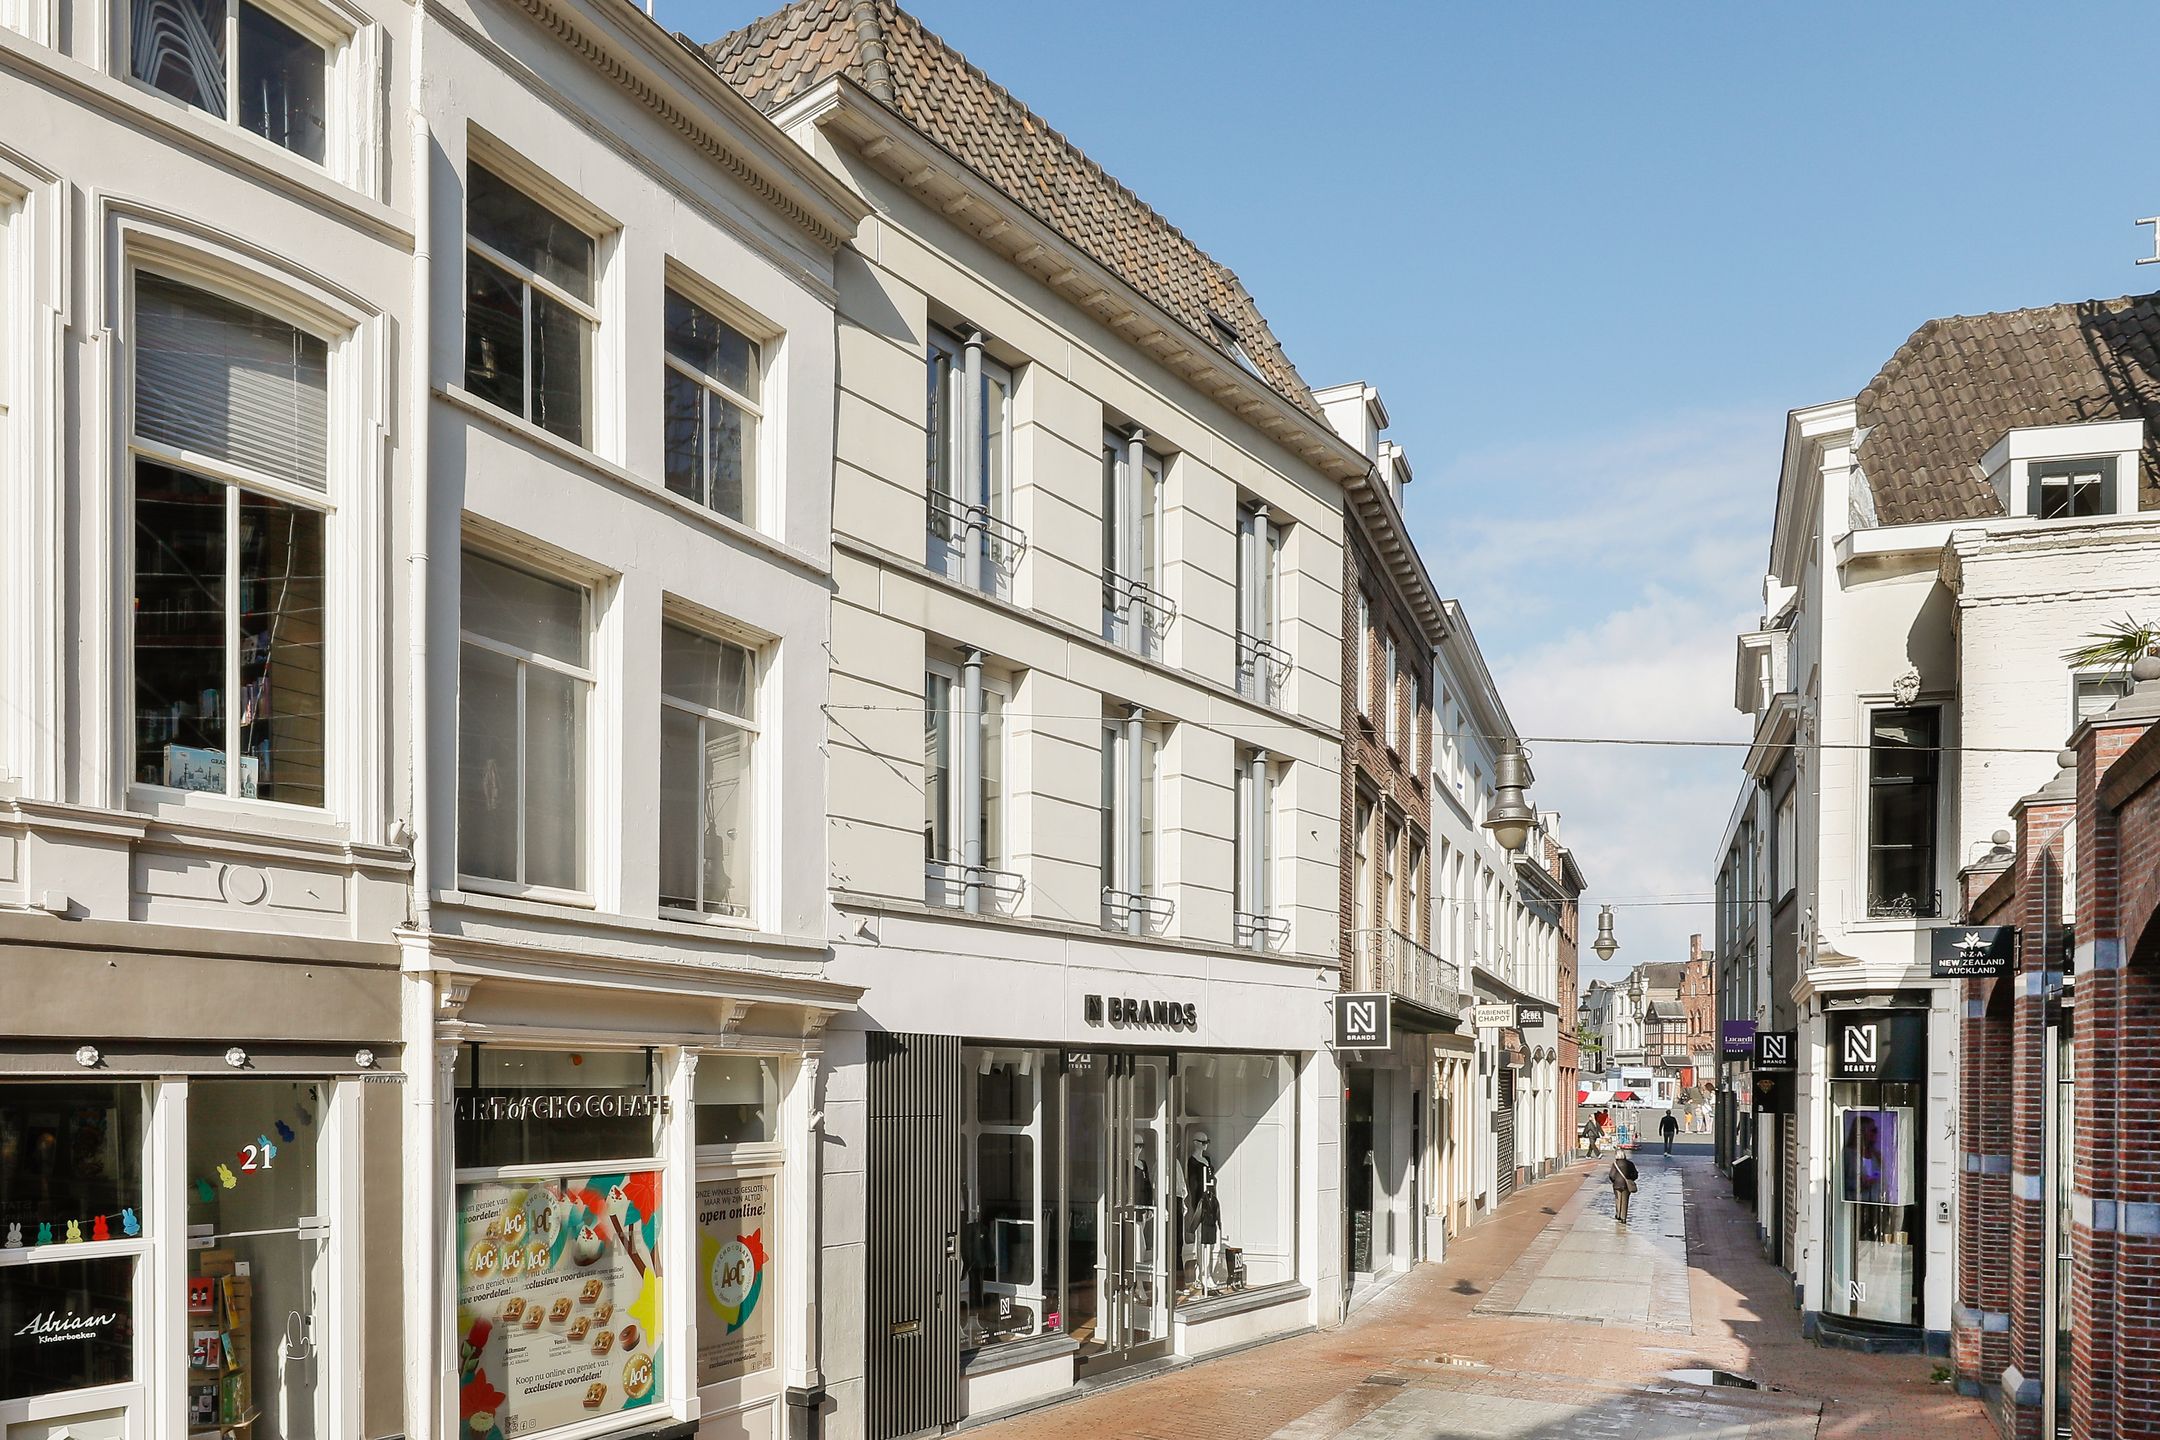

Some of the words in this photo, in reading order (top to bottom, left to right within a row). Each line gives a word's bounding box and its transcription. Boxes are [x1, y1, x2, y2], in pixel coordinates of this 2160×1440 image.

[1939, 959, 1960, 967] NEW
[1962, 958, 2005, 966] ZEALAND
[1947, 967, 1996, 975] AUCKLAND
[1083, 995, 1102, 1021] N
[1108, 997, 1196, 1027] BRANDS
[1346, 1001, 1376, 1033] N
[1477, 1015, 1511, 1023] CHAPOT
[1520, 1009, 1543, 1020] SIEBEL
[1763, 1035, 1787, 1059] N
[1844, 1025, 1877, 1063] N
[1844, 1064, 1877, 1072] BEAUTY
[241, 1144, 272, 1170] 21
[712, 1188, 733, 1196] WINKEL
[704, 1197, 720, 1206] MAAR
[700, 1210, 726, 1225] open
[729, 1203, 767, 1219] online!
[485, 1279, 506, 1291] geniet
[473, 1286, 512, 1302] voordelen!
[14, 1311, 117, 1336] Adriaan
[38, 1332, 96, 1344] Kinderboeken
[515, 1375, 534, 1385] Koop
[535, 1373, 545, 1381] nu
[545, 1368, 567, 1379] online
[567, 1366, 576, 1374] en
[576, 1363, 597, 1374] geniet
[597, 1359, 609, 1367] van
[524, 1380, 564, 1395] exclusieve
[564, 1370, 602, 1386] voordelen!
